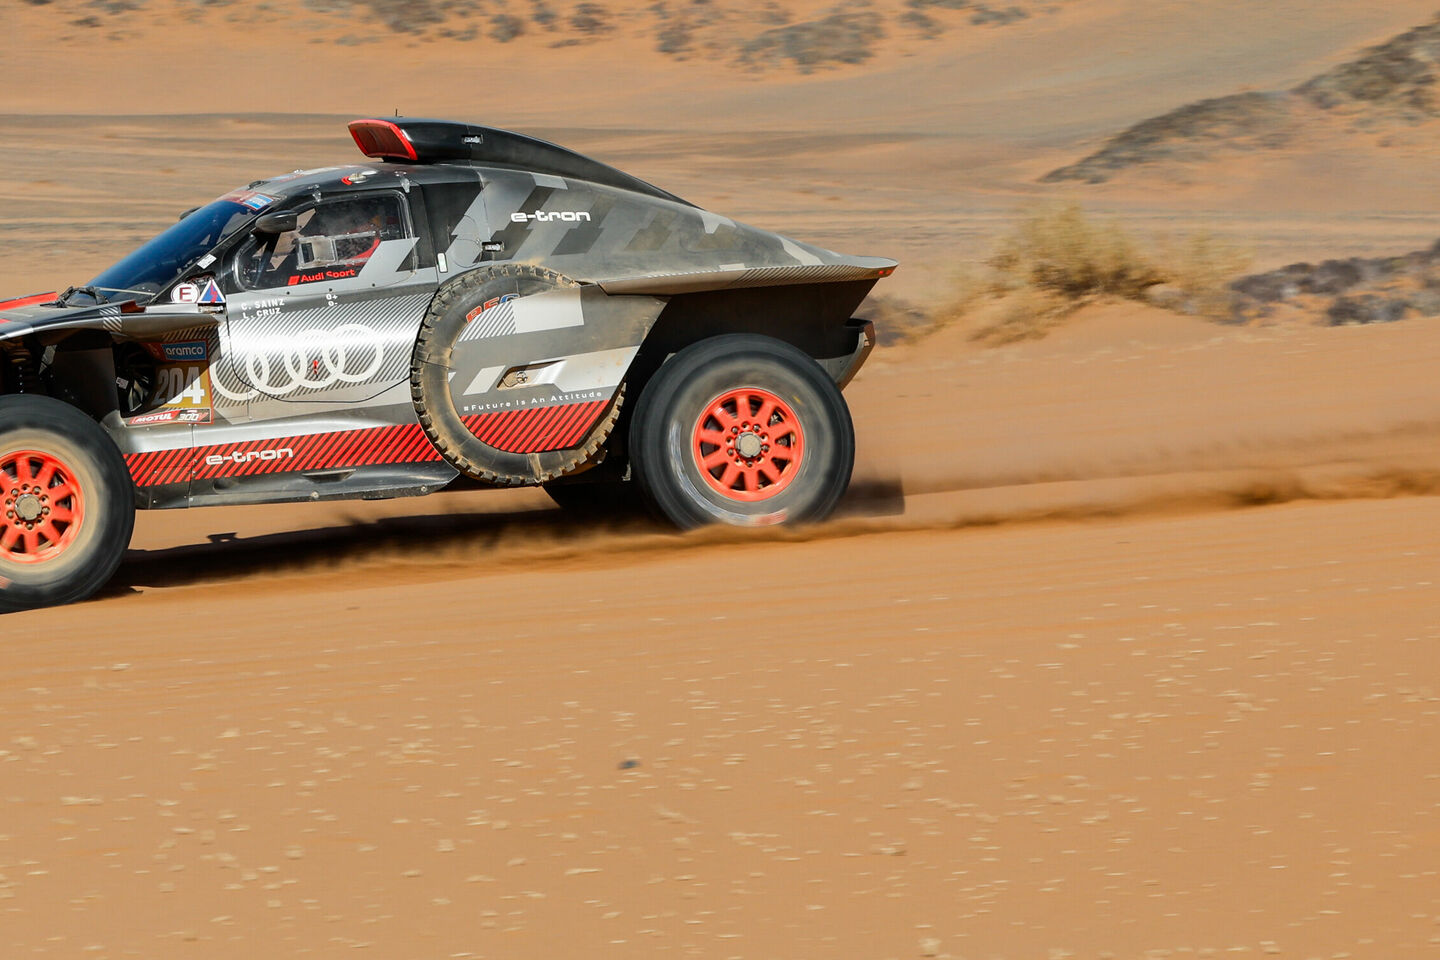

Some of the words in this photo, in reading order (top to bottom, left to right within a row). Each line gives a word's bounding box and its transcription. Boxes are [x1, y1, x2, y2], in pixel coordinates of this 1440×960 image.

[511, 210, 591, 222] e-tron
[301, 272, 325, 283] Audi
[179, 286, 192, 302] E
[241, 302, 252, 310] C.
[255, 298, 285, 309] SAINZ
[242, 312, 254, 320] L.
[256, 307, 282, 318] CRUZ
[165, 346, 204, 356] aramco
[151, 366, 206, 406] 204
[463, 402, 511, 412] #Future
[550, 391, 602, 402] Attitude
[135, 412, 173, 423] MOTUL
[177, 412, 209, 422] 300V
[206, 448, 293, 465] e-tron
